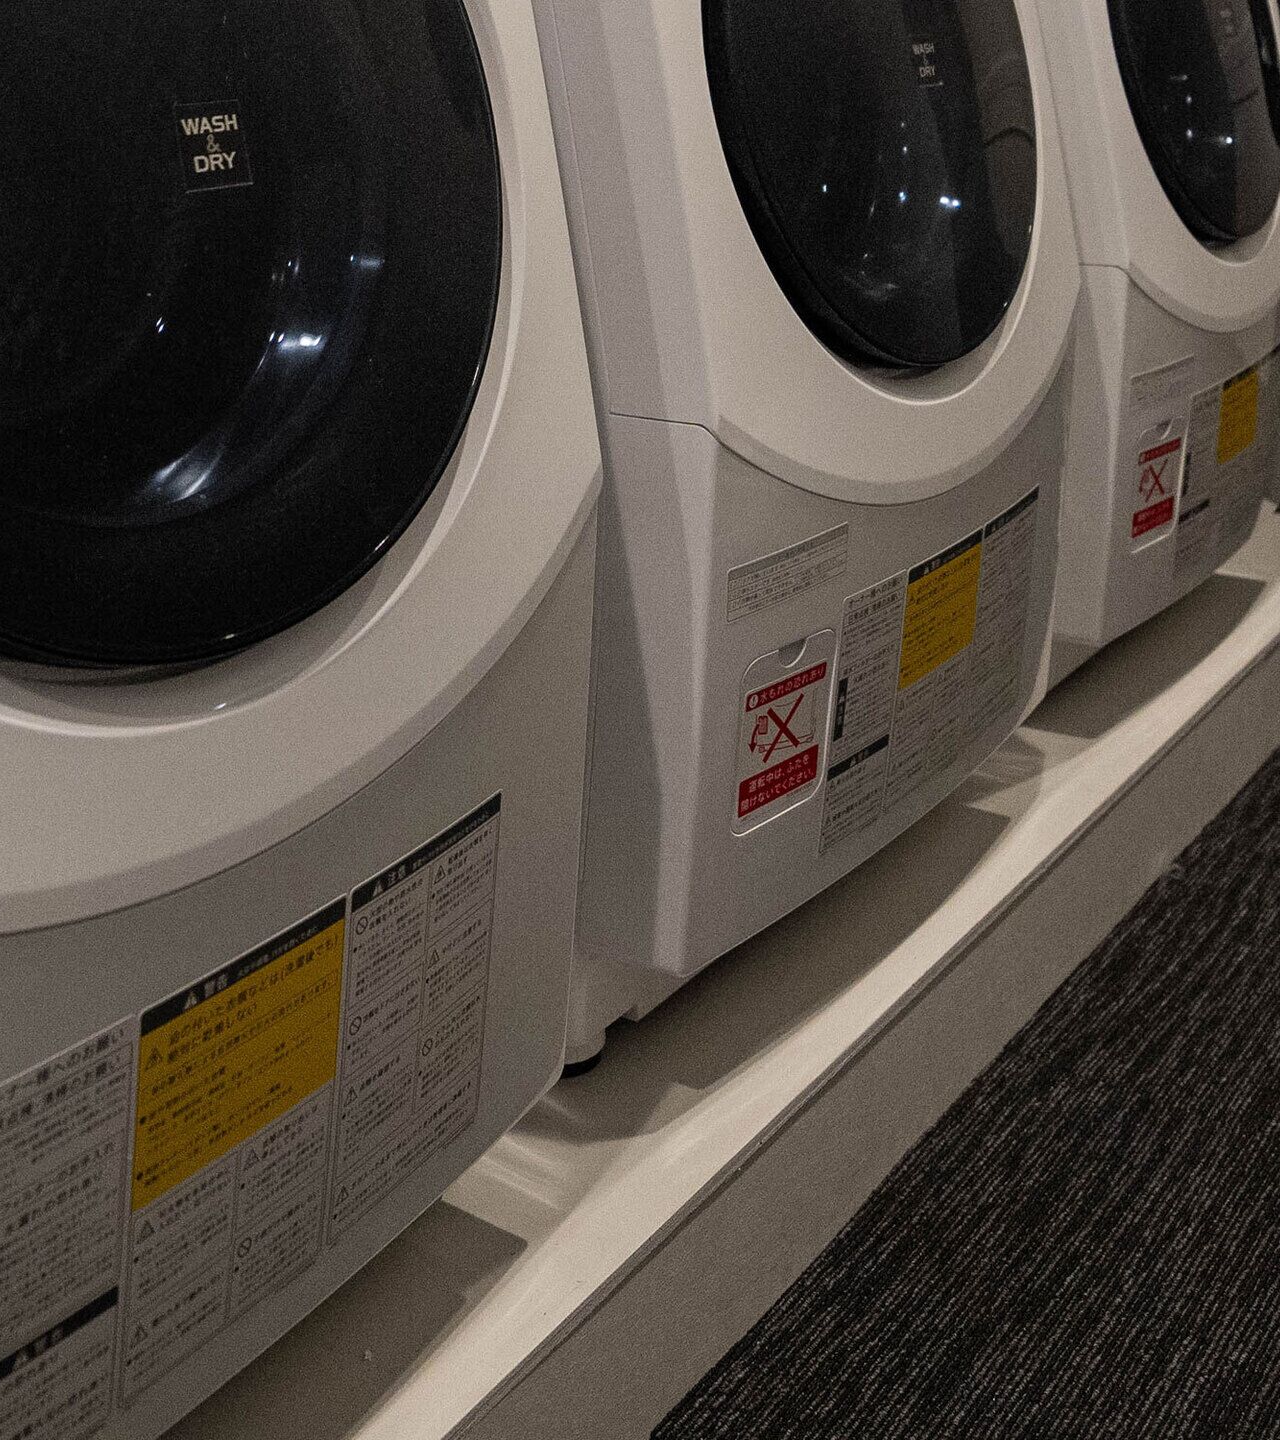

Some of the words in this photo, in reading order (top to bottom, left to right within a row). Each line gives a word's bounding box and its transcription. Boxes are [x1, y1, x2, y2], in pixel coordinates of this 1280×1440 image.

[180, 113, 239, 136] WASH
[206, 133, 222, 153] &
[193, 151, 237, 173] DRY
